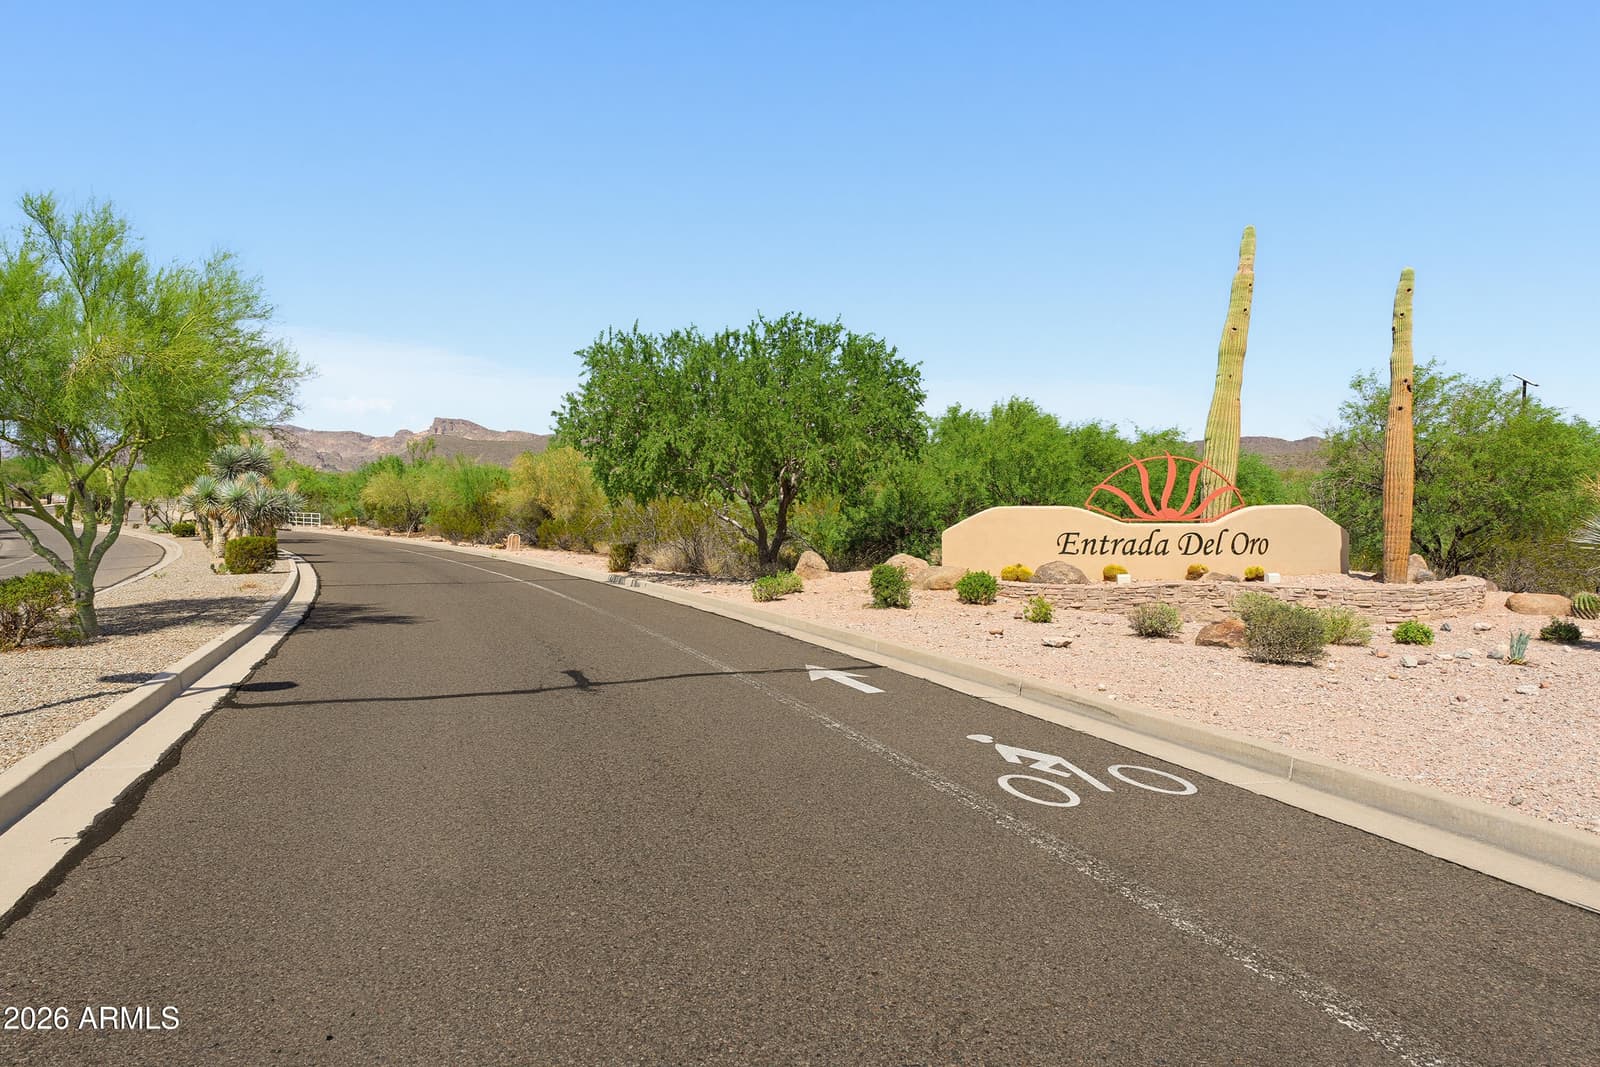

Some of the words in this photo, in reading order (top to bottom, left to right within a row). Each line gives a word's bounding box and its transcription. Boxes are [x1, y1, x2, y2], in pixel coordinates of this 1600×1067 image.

[1056, 528, 1170, 556] Entrada
[1178, 528, 1229, 555] Del
[1231, 532, 1269, 555] Oro
